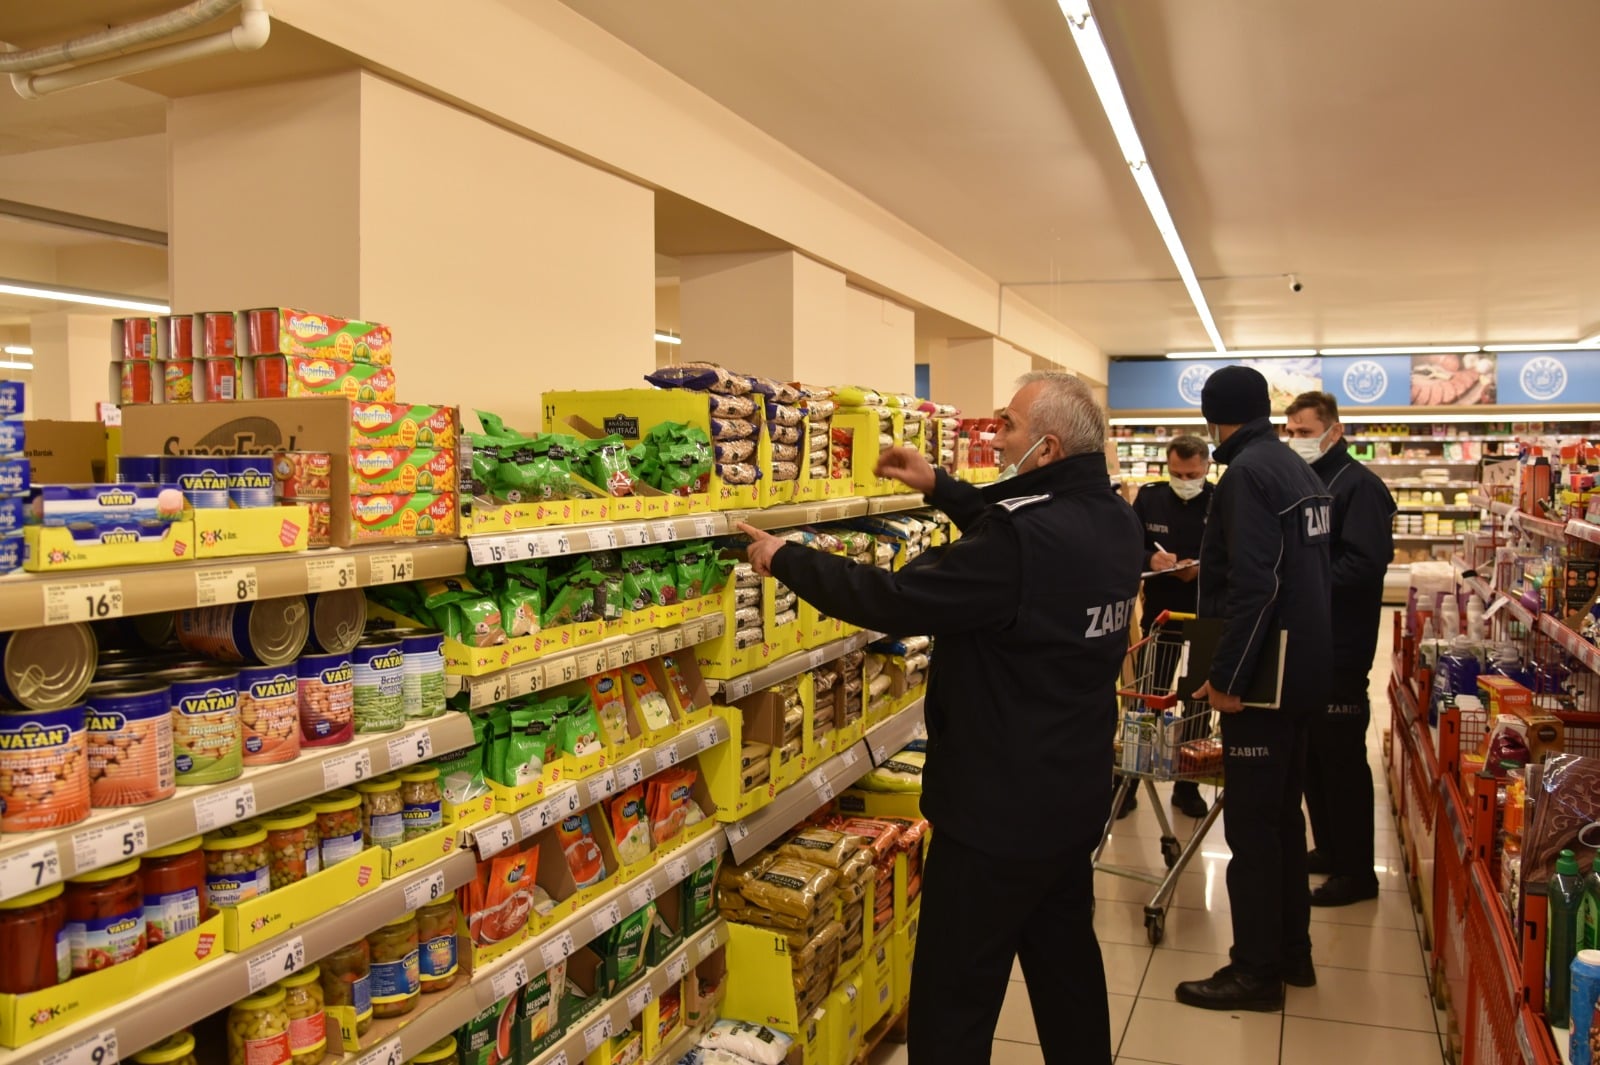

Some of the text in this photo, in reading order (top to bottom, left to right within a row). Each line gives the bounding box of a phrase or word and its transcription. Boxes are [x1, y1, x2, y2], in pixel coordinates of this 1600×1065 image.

[290, 316, 328, 335] SuperFresh
[299, 362, 336, 380] SuperFresh
[353, 406, 393, 423] SuperFresh
[356, 455, 393, 469] SuperFresh
[184, 478, 227, 489] VATAN
[229, 476, 271, 487] VATAN
[100, 494, 133, 505] VATAN
[356, 501, 393, 515] SuperFresh
[490, 546, 502, 561] 15
[528, 543, 535, 556] 9
[339, 569, 348, 587] 3
[392, 563, 406, 581] 14
[236, 580, 248, 600] 8
[86, 595, 110, 618] 16
[1085, 597, 1136, 639] ZABI
[597, 658, 603, 672] 6
[562, 667, 573, 682] 15
[256, 680, 297, 698] VATAN
[531, 676, 537, 691] 3
[494, 685, 501, 701] 6
[186, 695, 235, 713] VATAN
[0, 729, 64, 750] VATAN
[417, 739, 426, 758] 5
[670, 751, 676, 764] 3
[355, 761, 364, 779] 5
[632, 768, 639, 782] 3
[606, 779, 612, 793] 4
[236, 797, 246, 818] 5
[568, 797, 575, 811] 6
[540, 811, 548, 827] 2
[122, 832, 136, 856] 5
[502, 831, 509, 847] 5
[31, 861, 45, 885] 7
[211, 882, 239, 891] VATAN
[431, 883, 438, 899] 8
[610, 910, 617, 924] 3
[109, 921, 137, 934] VATAN
[563, 941, 570, 956] 3
[284, 953, 296, 972] 4
[515, 971, 522, 987] 3
[602, 1026, 609, 1040] 4
[91, 1046, 105, 1065] 9
